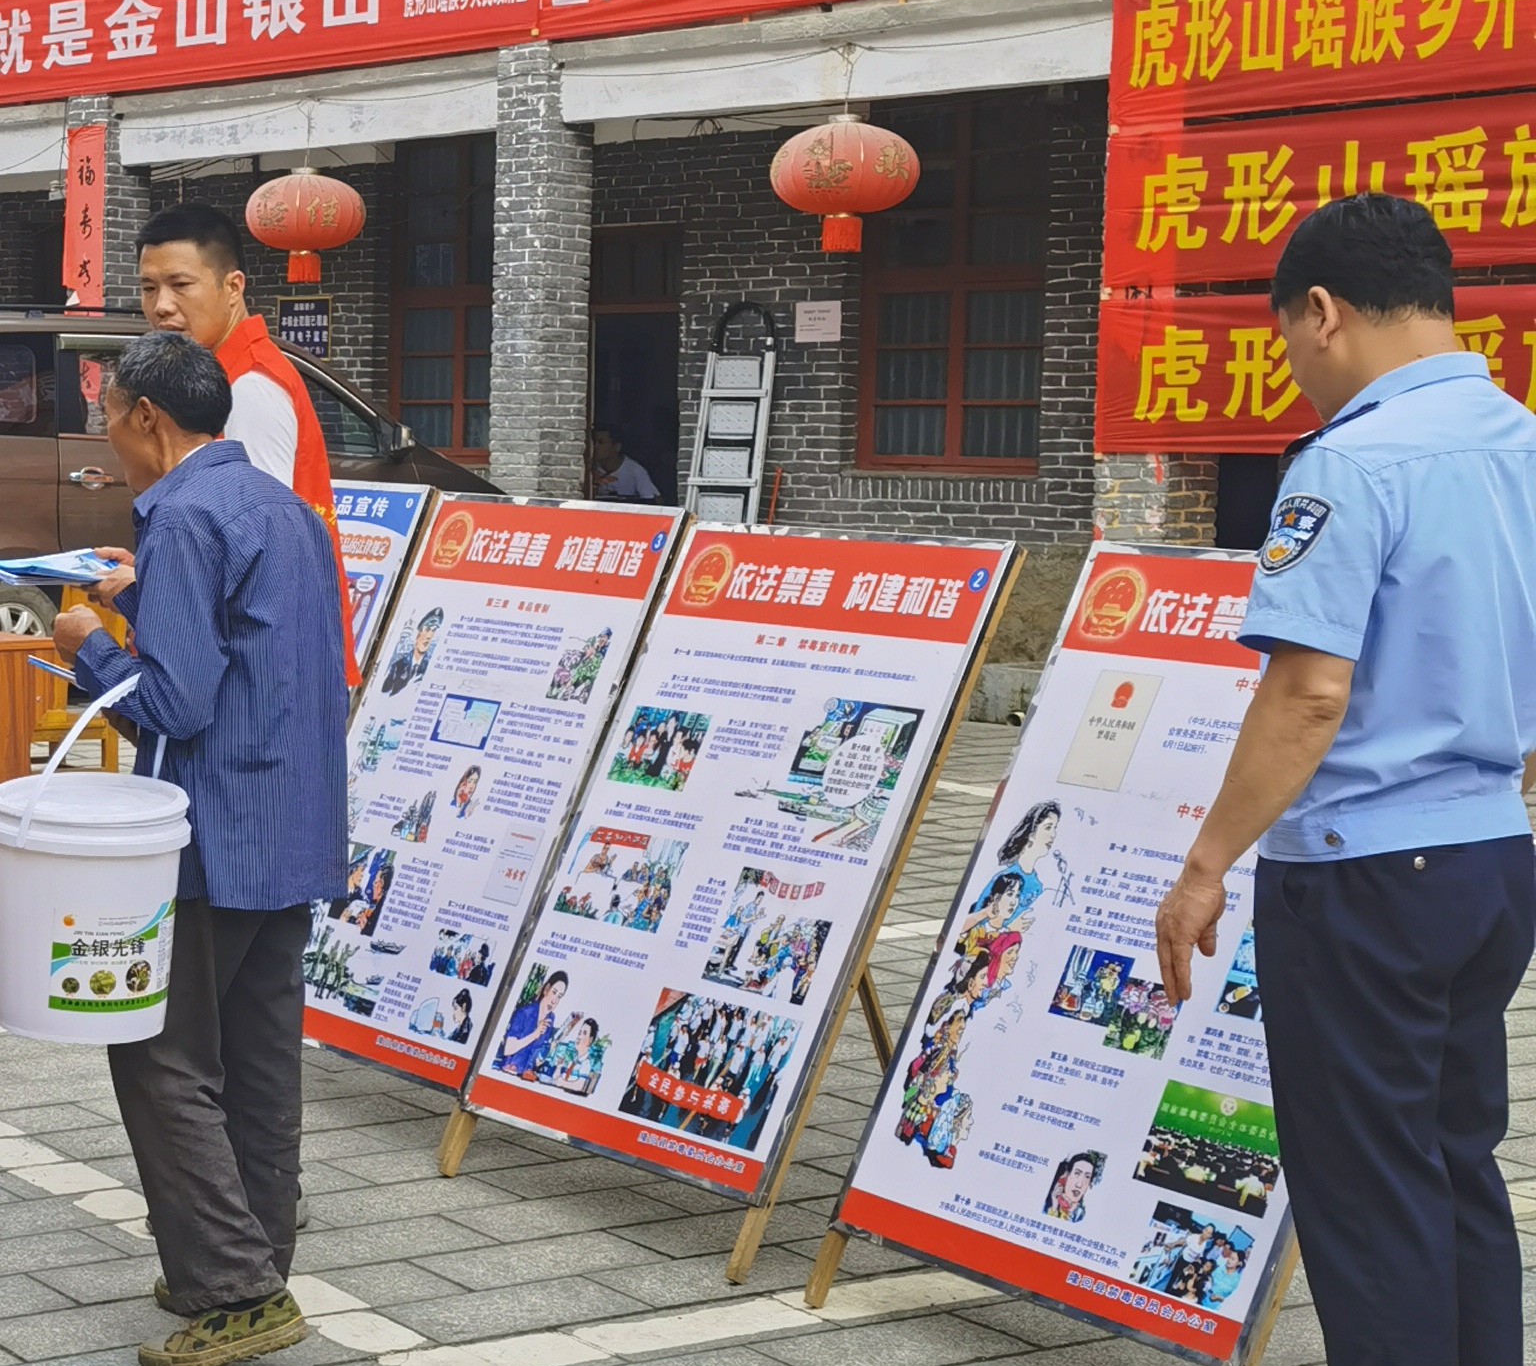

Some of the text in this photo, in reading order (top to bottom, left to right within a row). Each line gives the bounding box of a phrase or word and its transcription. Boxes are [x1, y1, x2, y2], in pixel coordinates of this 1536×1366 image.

[465, 527, 648, 578] 依法禁毒 构建和谐
[725, 562, 964, 619] 依法禁毒 构建和谐
[973, 570, 984, 587] 2
[71, 938, 145, 958] 金银先锋
[647, 1072, 732, 1116] 全民参与禁毒
[1066, 1270, 1217, 1335] 隆回县禁毒委员会办公室
